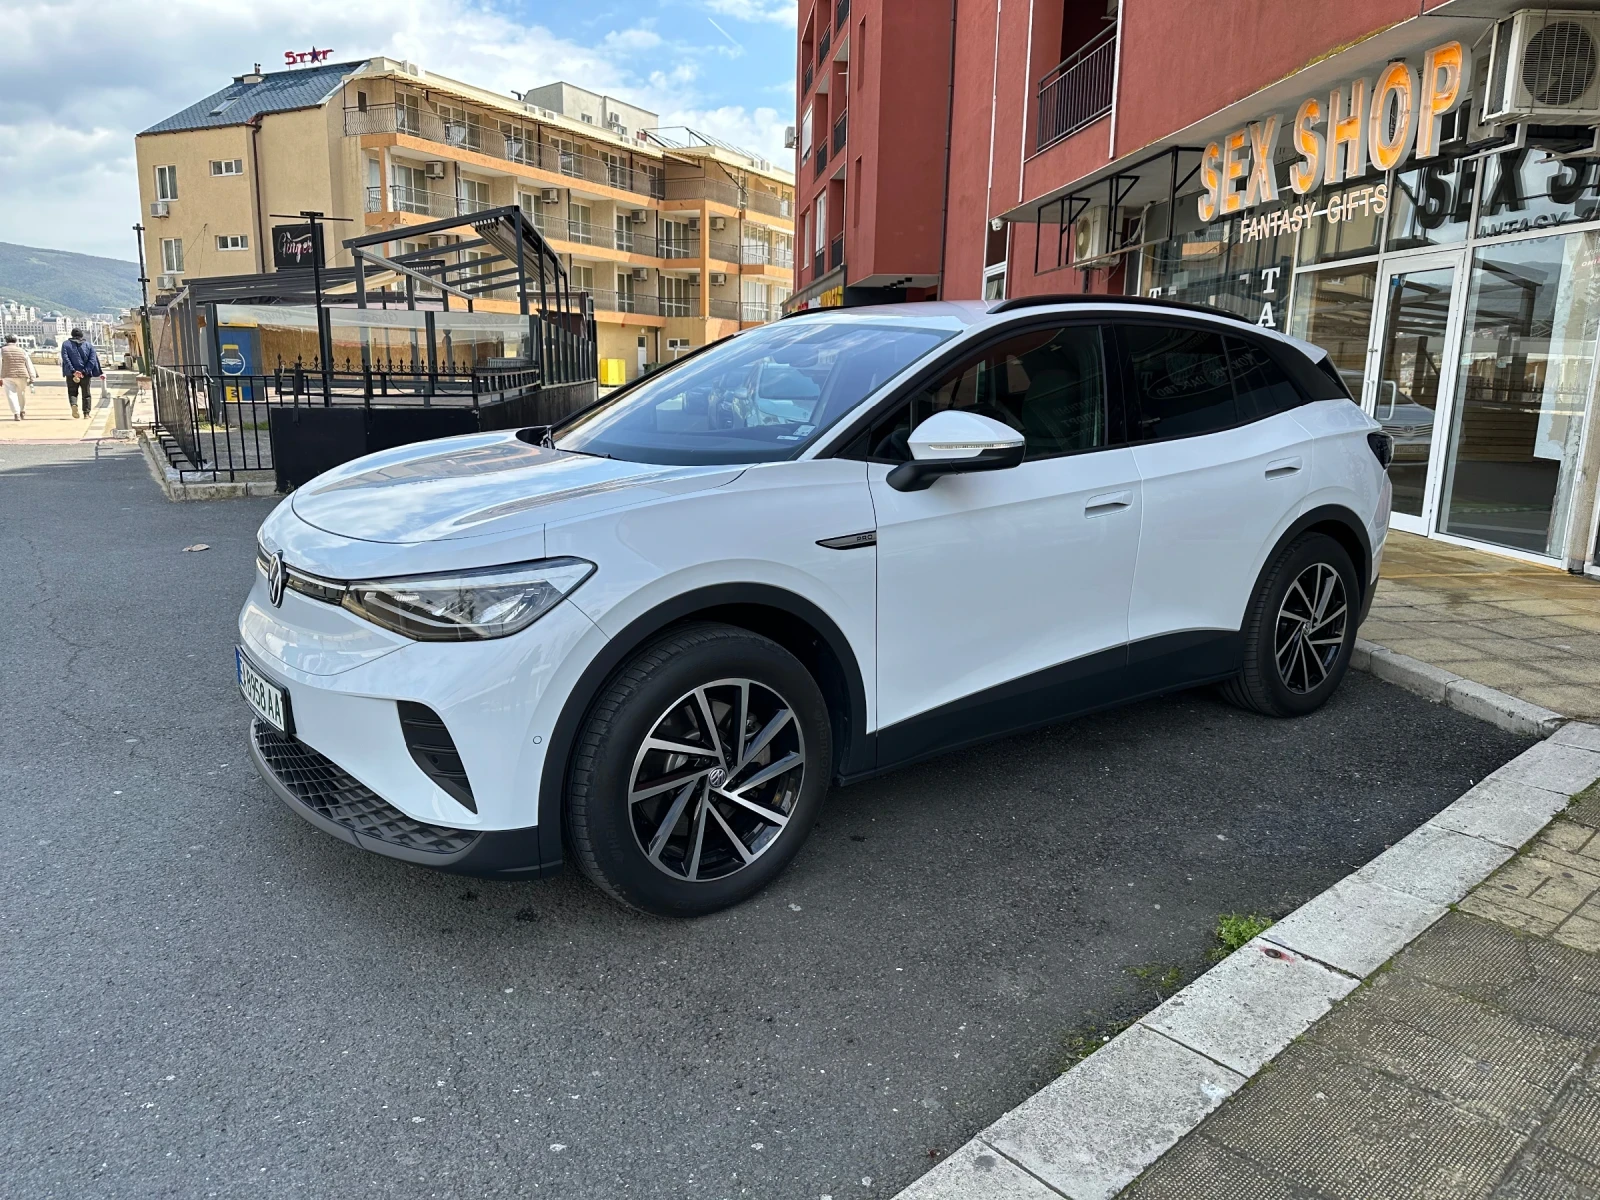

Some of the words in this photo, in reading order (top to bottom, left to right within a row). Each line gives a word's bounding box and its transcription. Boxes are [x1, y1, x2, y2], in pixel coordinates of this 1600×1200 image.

[1198, 114, 1282, 221] SEX
[1290, 41, 1469, 194] SHOP
[1240, 202, 1316, 243] FANTASY
[1327, 184, 1388, 224] GIFTS
[856, 534, 873, 542] PRO
[268, 688, 282, 725] AA
